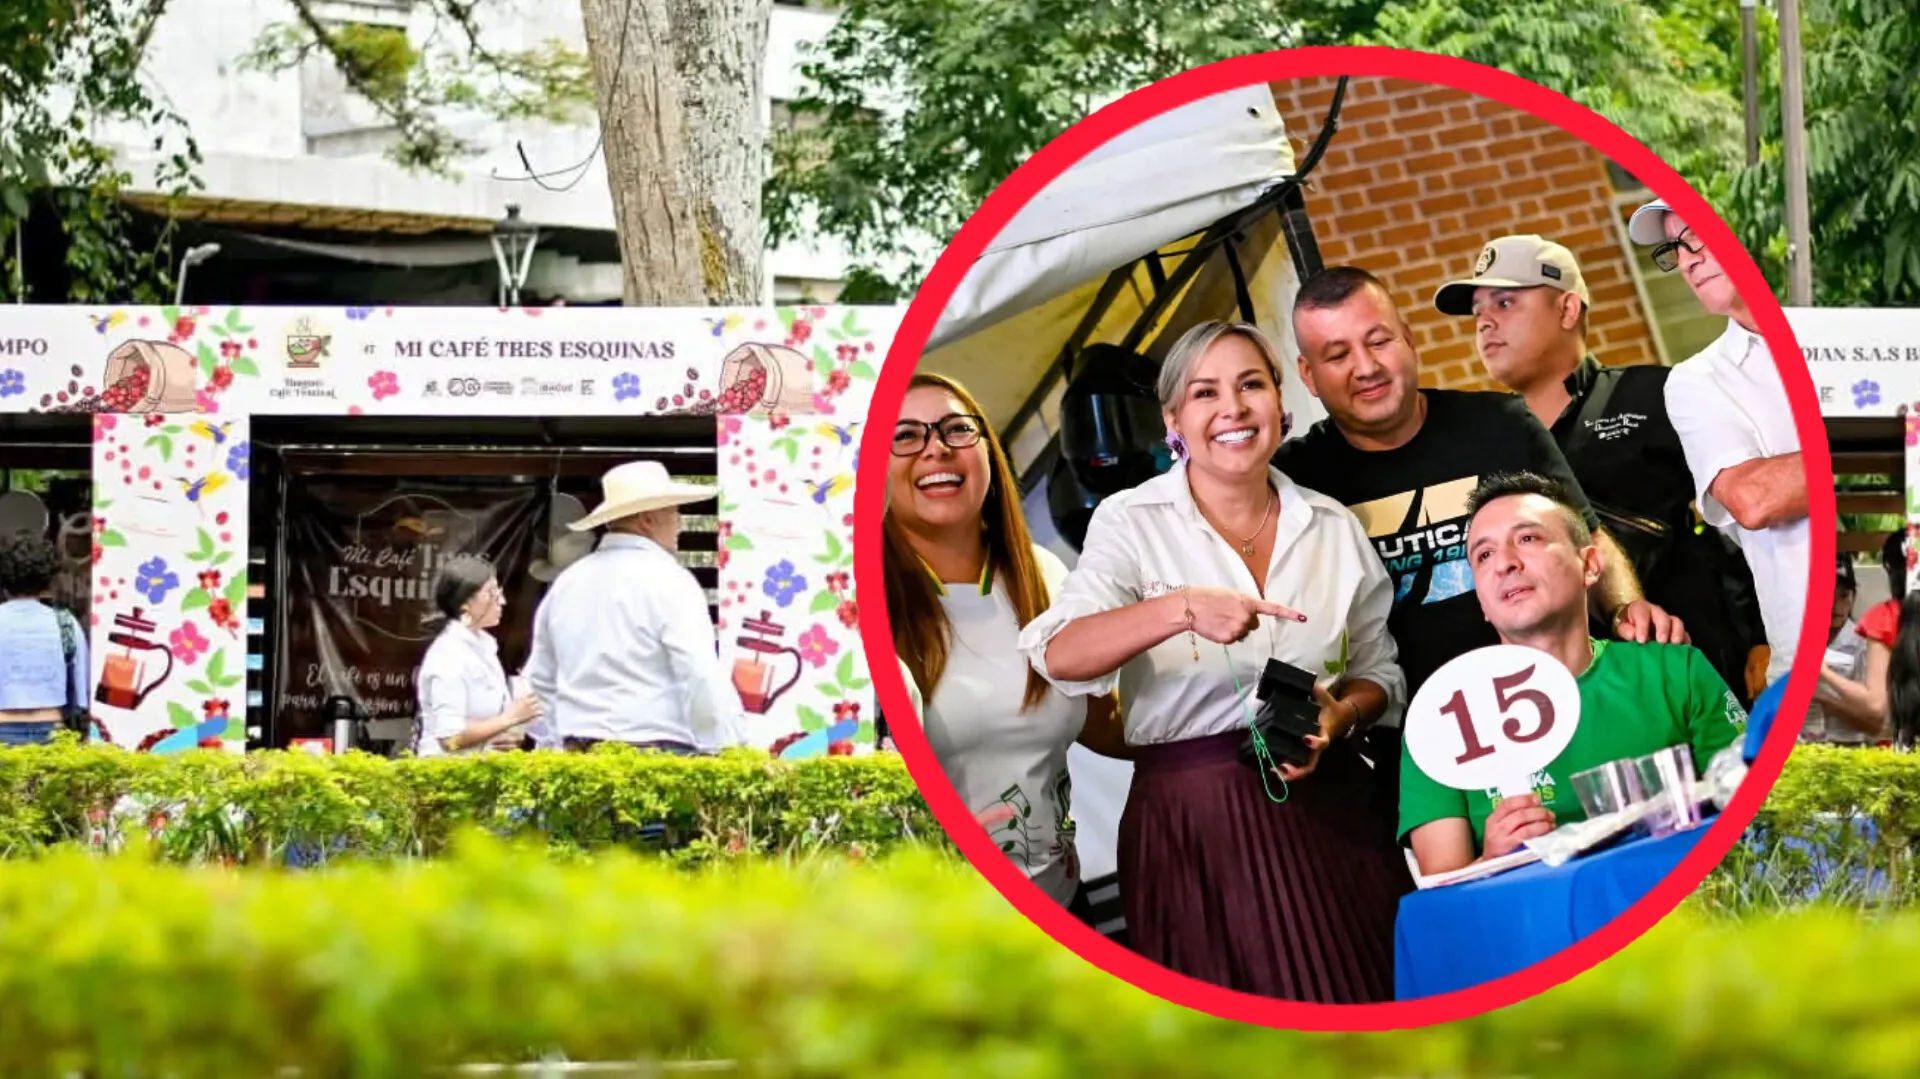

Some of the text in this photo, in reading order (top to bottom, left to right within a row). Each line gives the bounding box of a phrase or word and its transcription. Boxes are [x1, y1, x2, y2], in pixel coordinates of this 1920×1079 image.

[394, 336, 676, 362] MI CAFÉ TRES ESQUINAS
[1378, 523, 1471, 559] UTIC
[1384, 543, 1468, 573] ING 19
[328, 565, 430, 606] Esqui
[1439, 663, 1556, 765] 15
